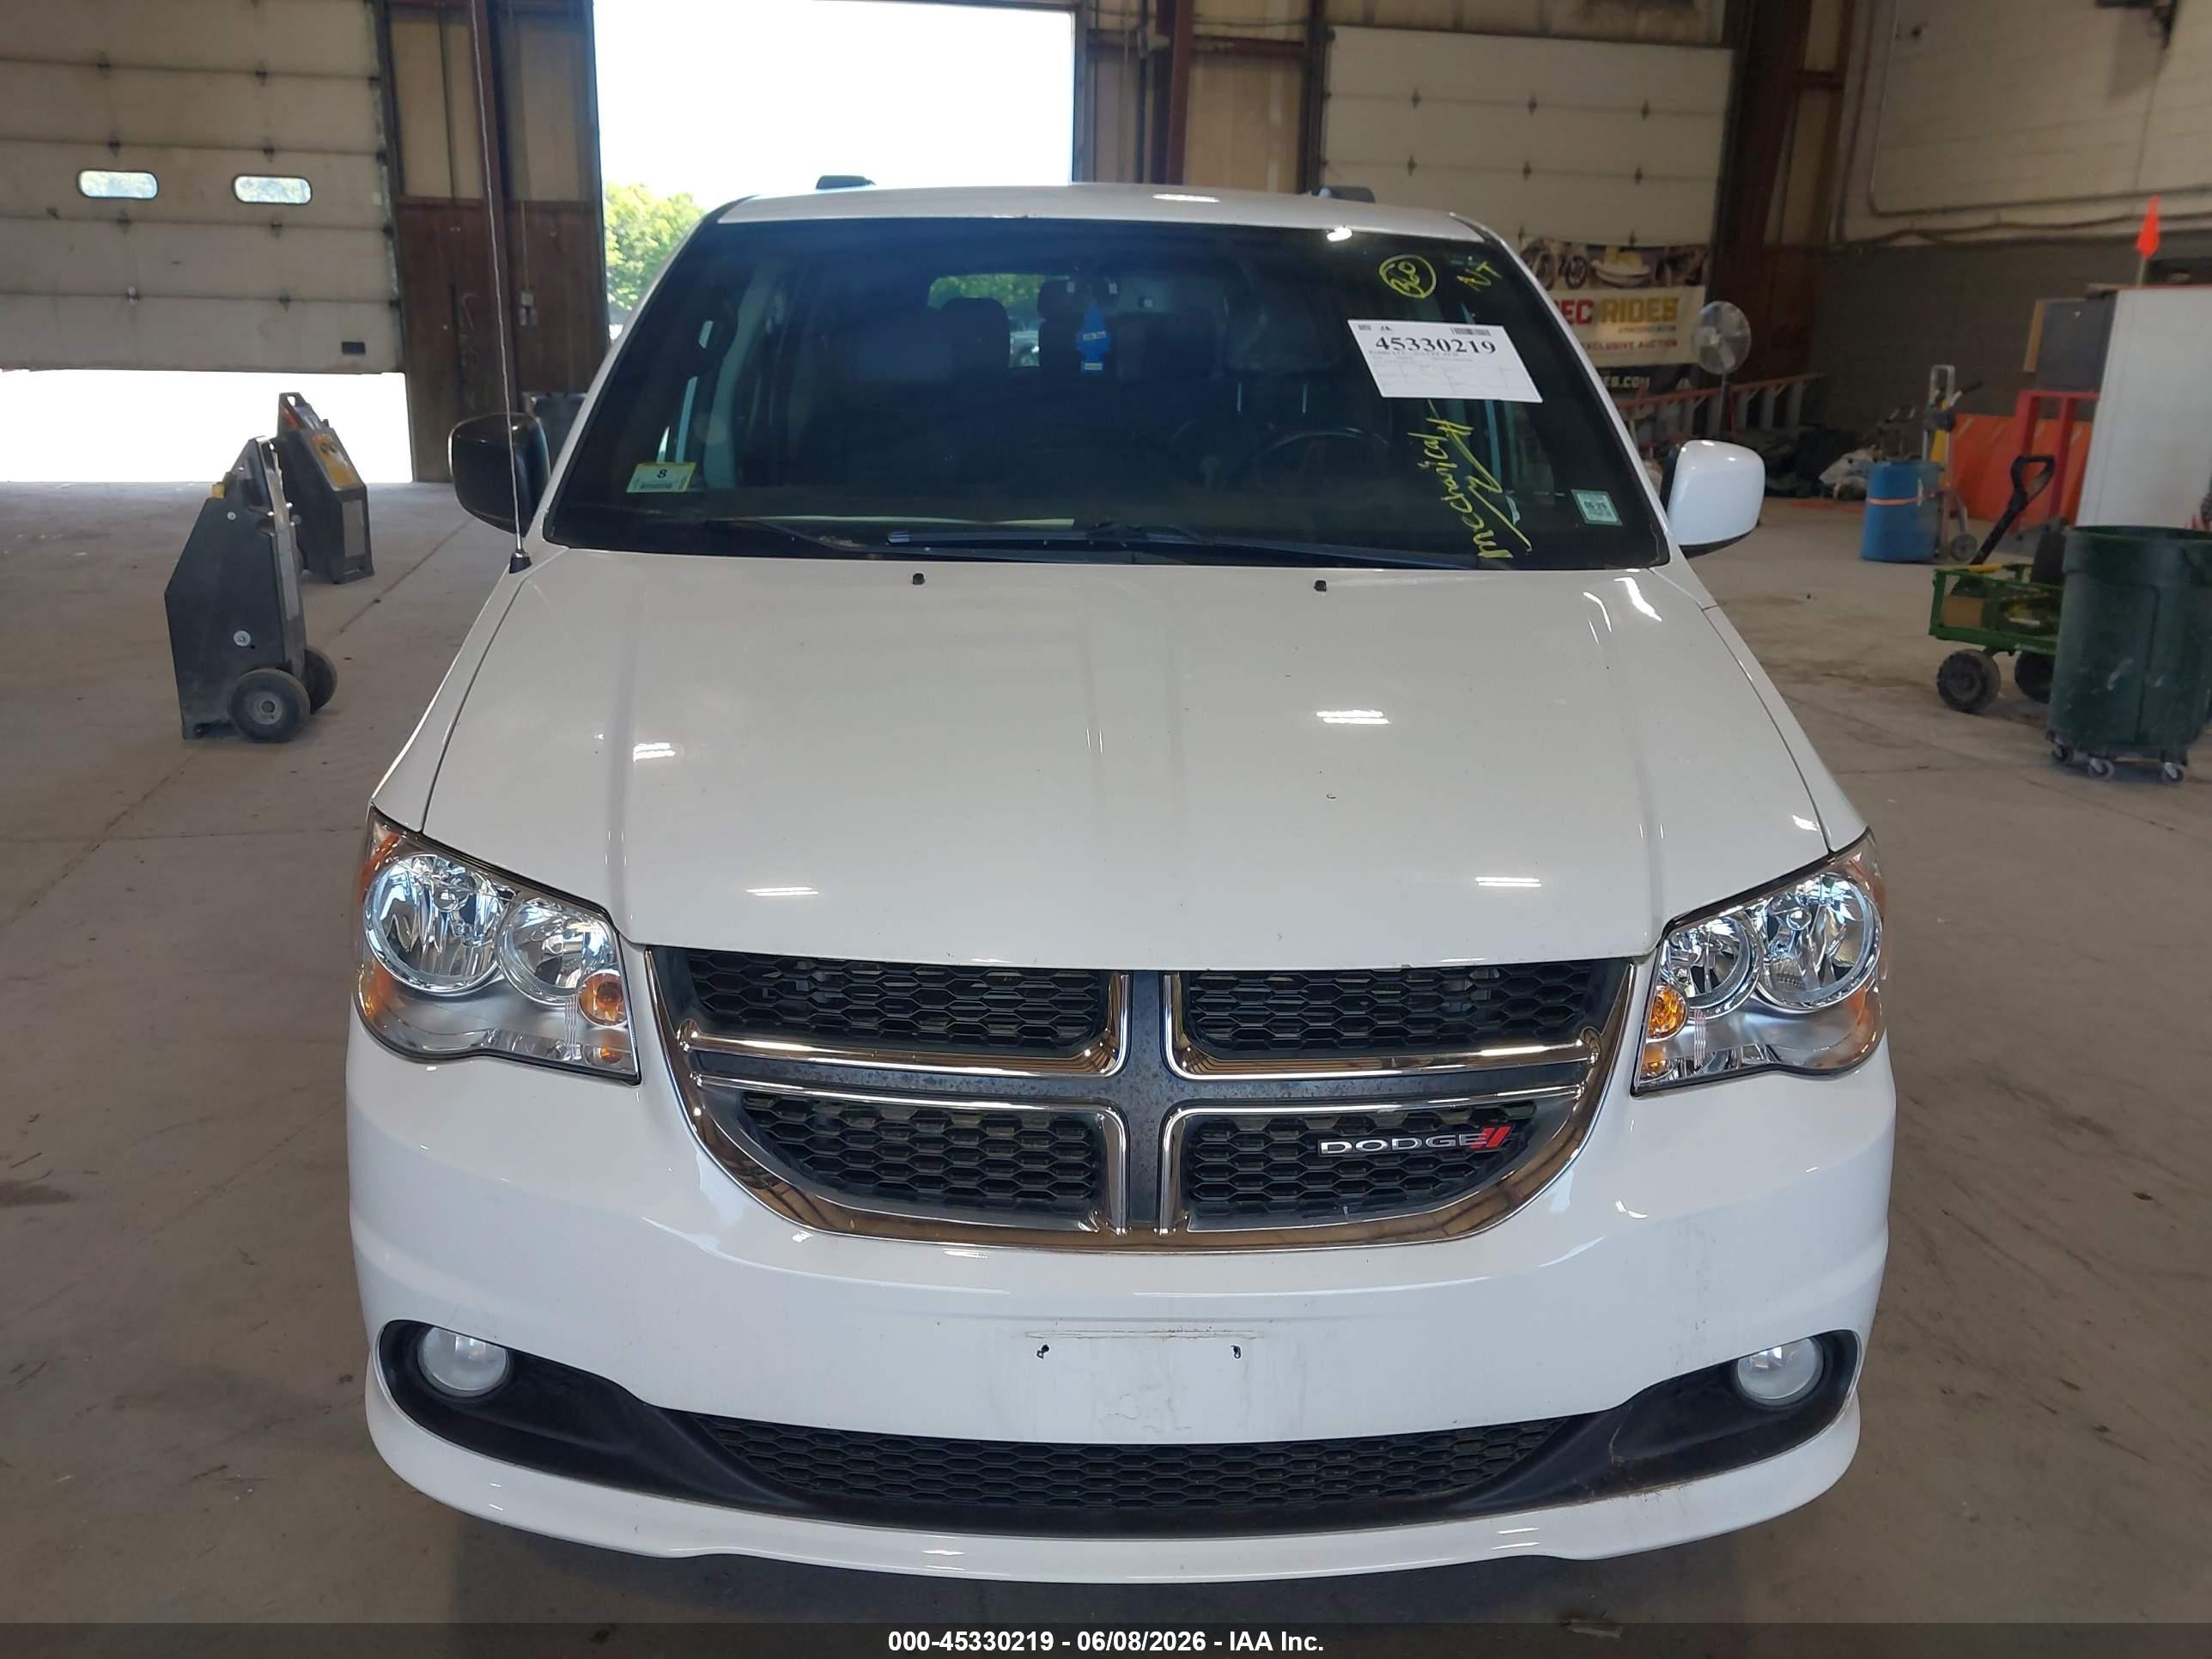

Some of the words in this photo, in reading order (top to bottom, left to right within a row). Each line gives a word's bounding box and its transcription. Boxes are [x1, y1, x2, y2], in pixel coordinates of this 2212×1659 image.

[1554, 299, 1595, 325] EC
[1601, 297, 1679, 323] RIDES
[1375, 337, 1497, 354] 45330219
[656, 469, 668, 478] 8
[1321, 1133, 1487, 1154] DODGE
